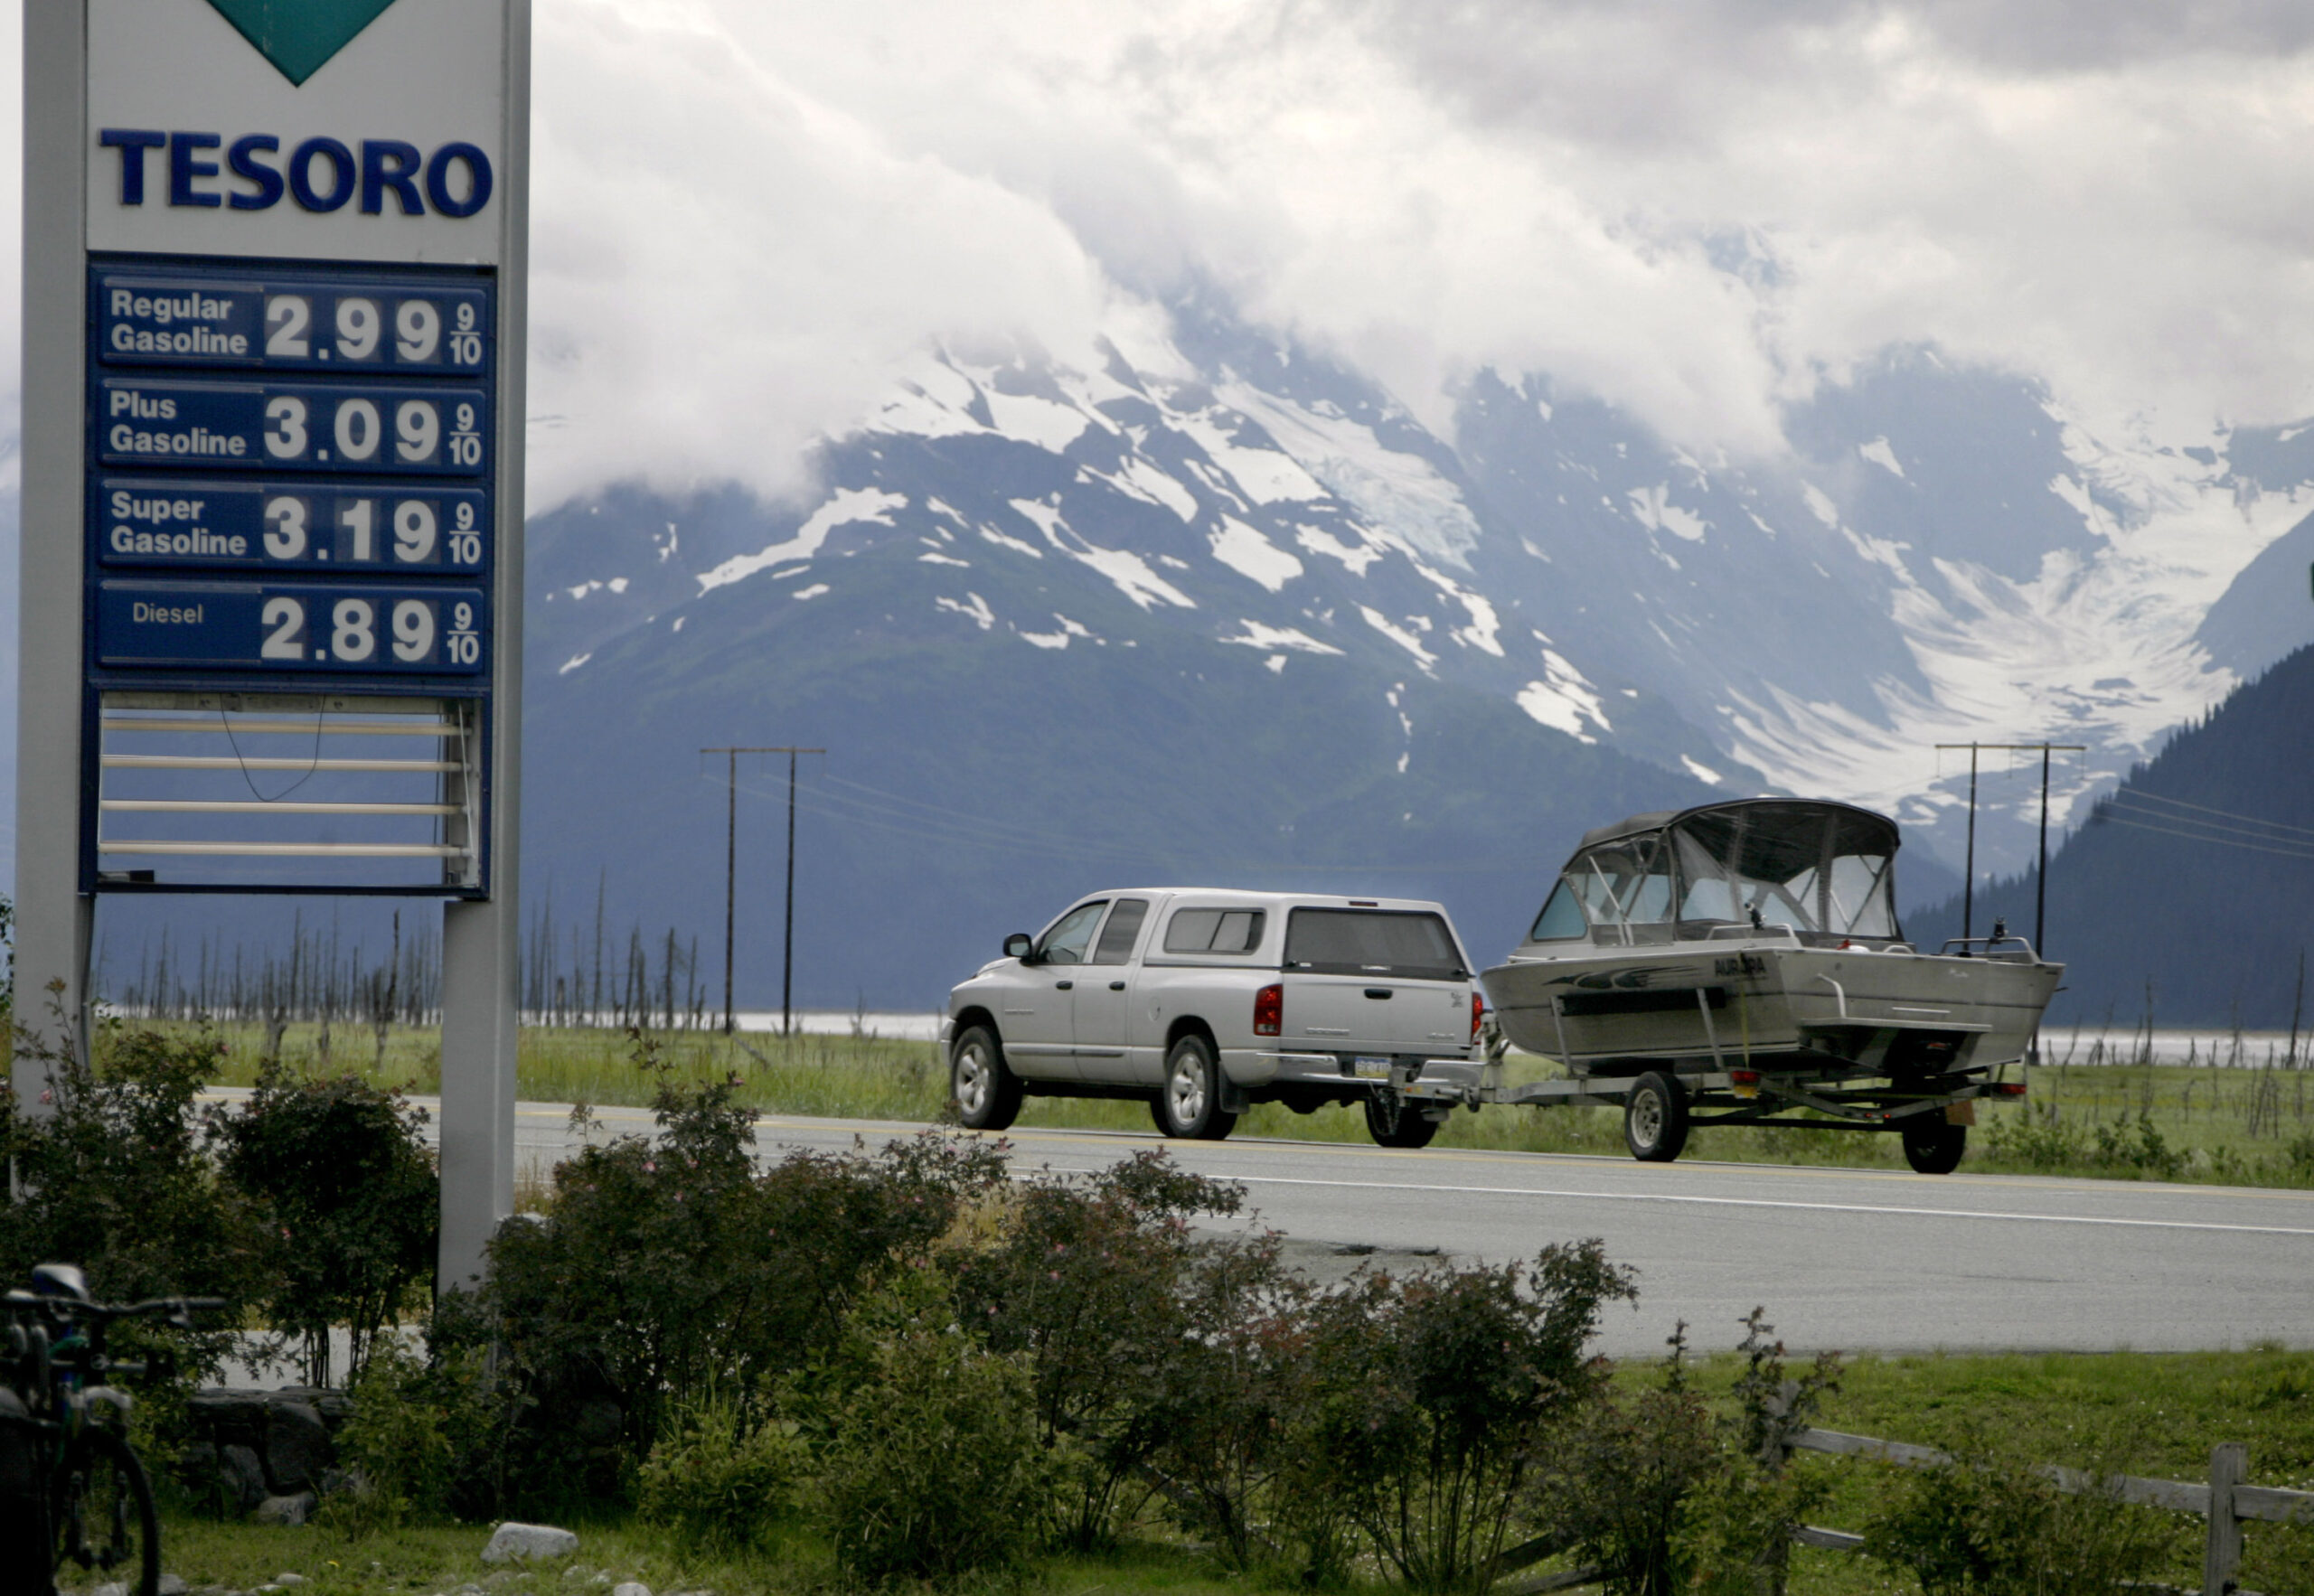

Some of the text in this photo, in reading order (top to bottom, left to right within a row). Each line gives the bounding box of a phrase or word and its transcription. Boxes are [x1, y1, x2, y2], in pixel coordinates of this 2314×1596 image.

[98, 128, 494, 220] TESORO
[110, 289, 233, 324] Regular
[110, 325, 249, 355] Gasoline
[266, 295, 440, 362] 2.99
[110, 390, 177, 419] Plus
[109, 424, 247, 456] Gasoline
[264, 396, 440, 463] 3.09
[111, 491, 205, 524] Super
[110, 525, 247, 556] Gasoline
[263, 495, 437, 563] 3.19
[133, 602, 203, 624] Diesel
[260, 596, 436, 662] 2.89
